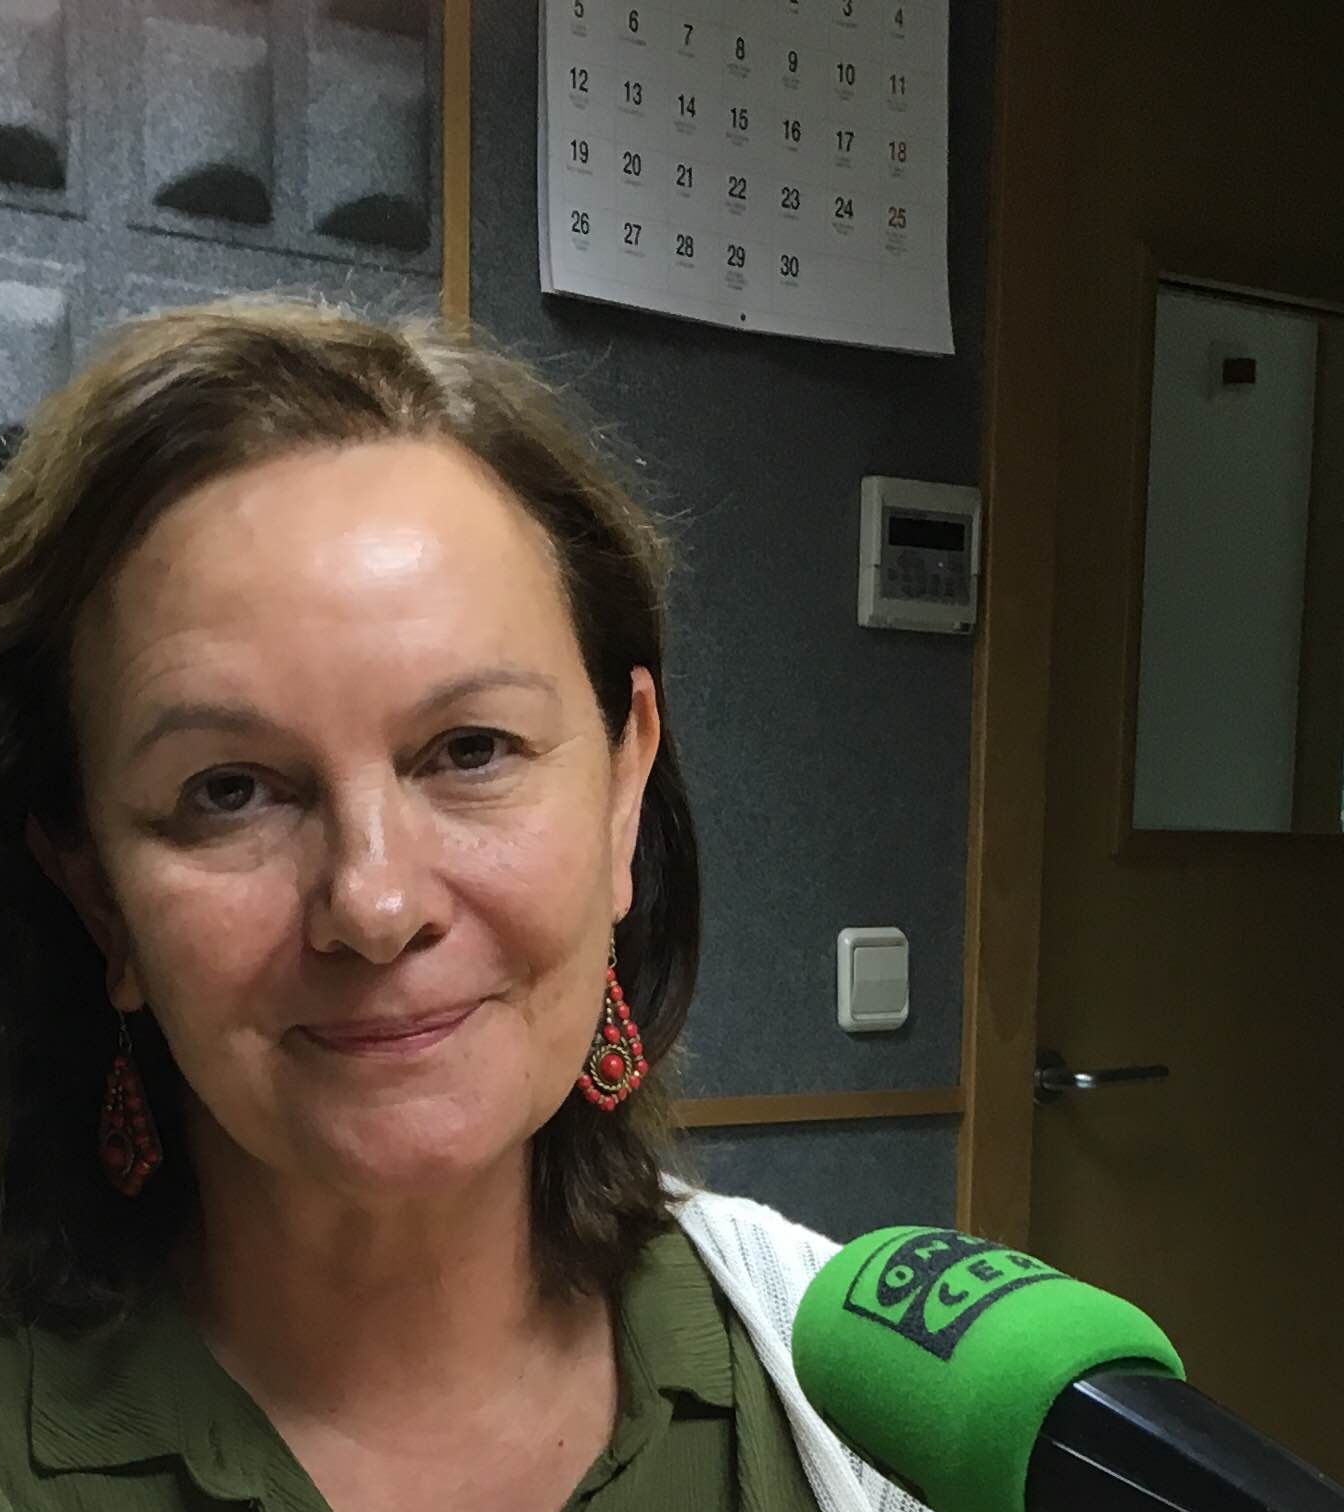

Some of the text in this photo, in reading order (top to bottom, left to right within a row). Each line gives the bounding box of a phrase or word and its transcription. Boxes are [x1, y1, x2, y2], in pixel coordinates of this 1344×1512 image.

[573, 0, 905, 95] 5 6 7 8 9 10 11
[841, 0, 904, 28] 3 4
[569, 67, 906, 163] 12 13 14 15 16 17 18
[570, 139, 906, 229] 19 20 21 22 23 24 25
[571, 210, 799, 278] 26 27 28 29 30
